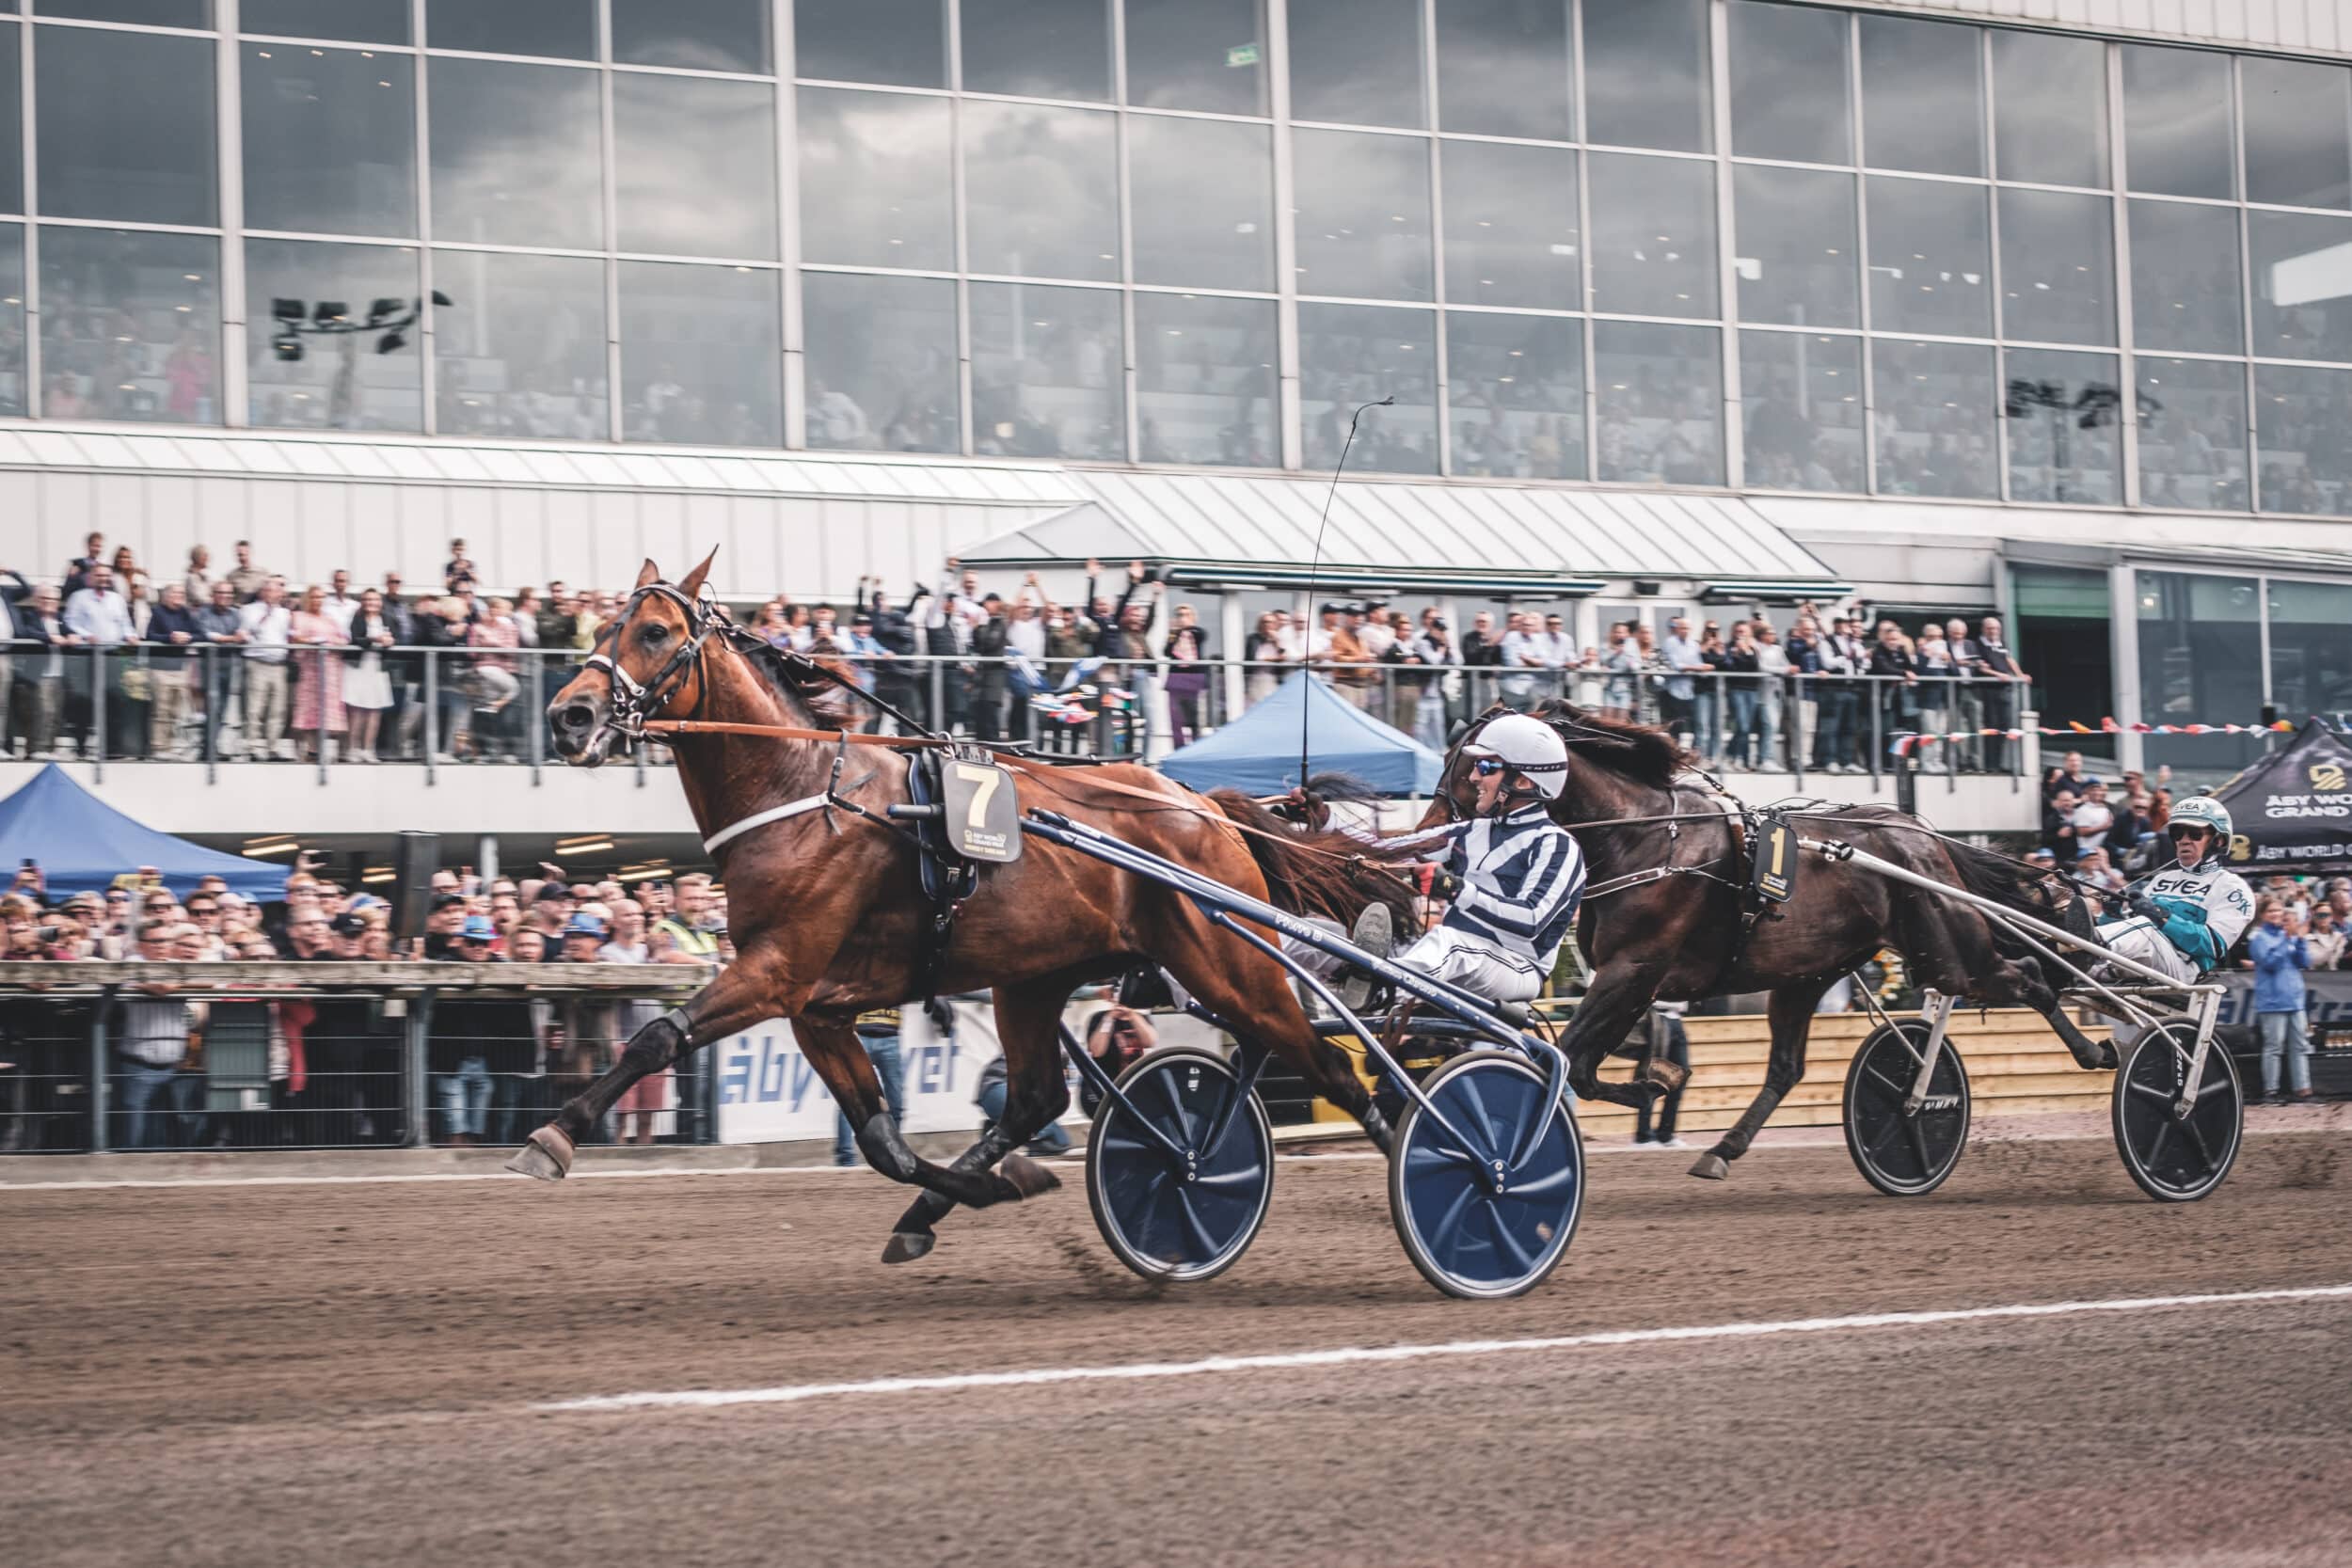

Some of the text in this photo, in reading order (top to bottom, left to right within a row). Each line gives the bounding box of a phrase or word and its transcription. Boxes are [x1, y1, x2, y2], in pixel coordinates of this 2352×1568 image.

[957, 764, 999, 828] 7
[2265, 806, 2350, 817] GRAND
[1771, 828, 1785, 875] 1
[2287, 844, 2344, 858] WORLD
[2153, 879, 2212, 896] SVEA
